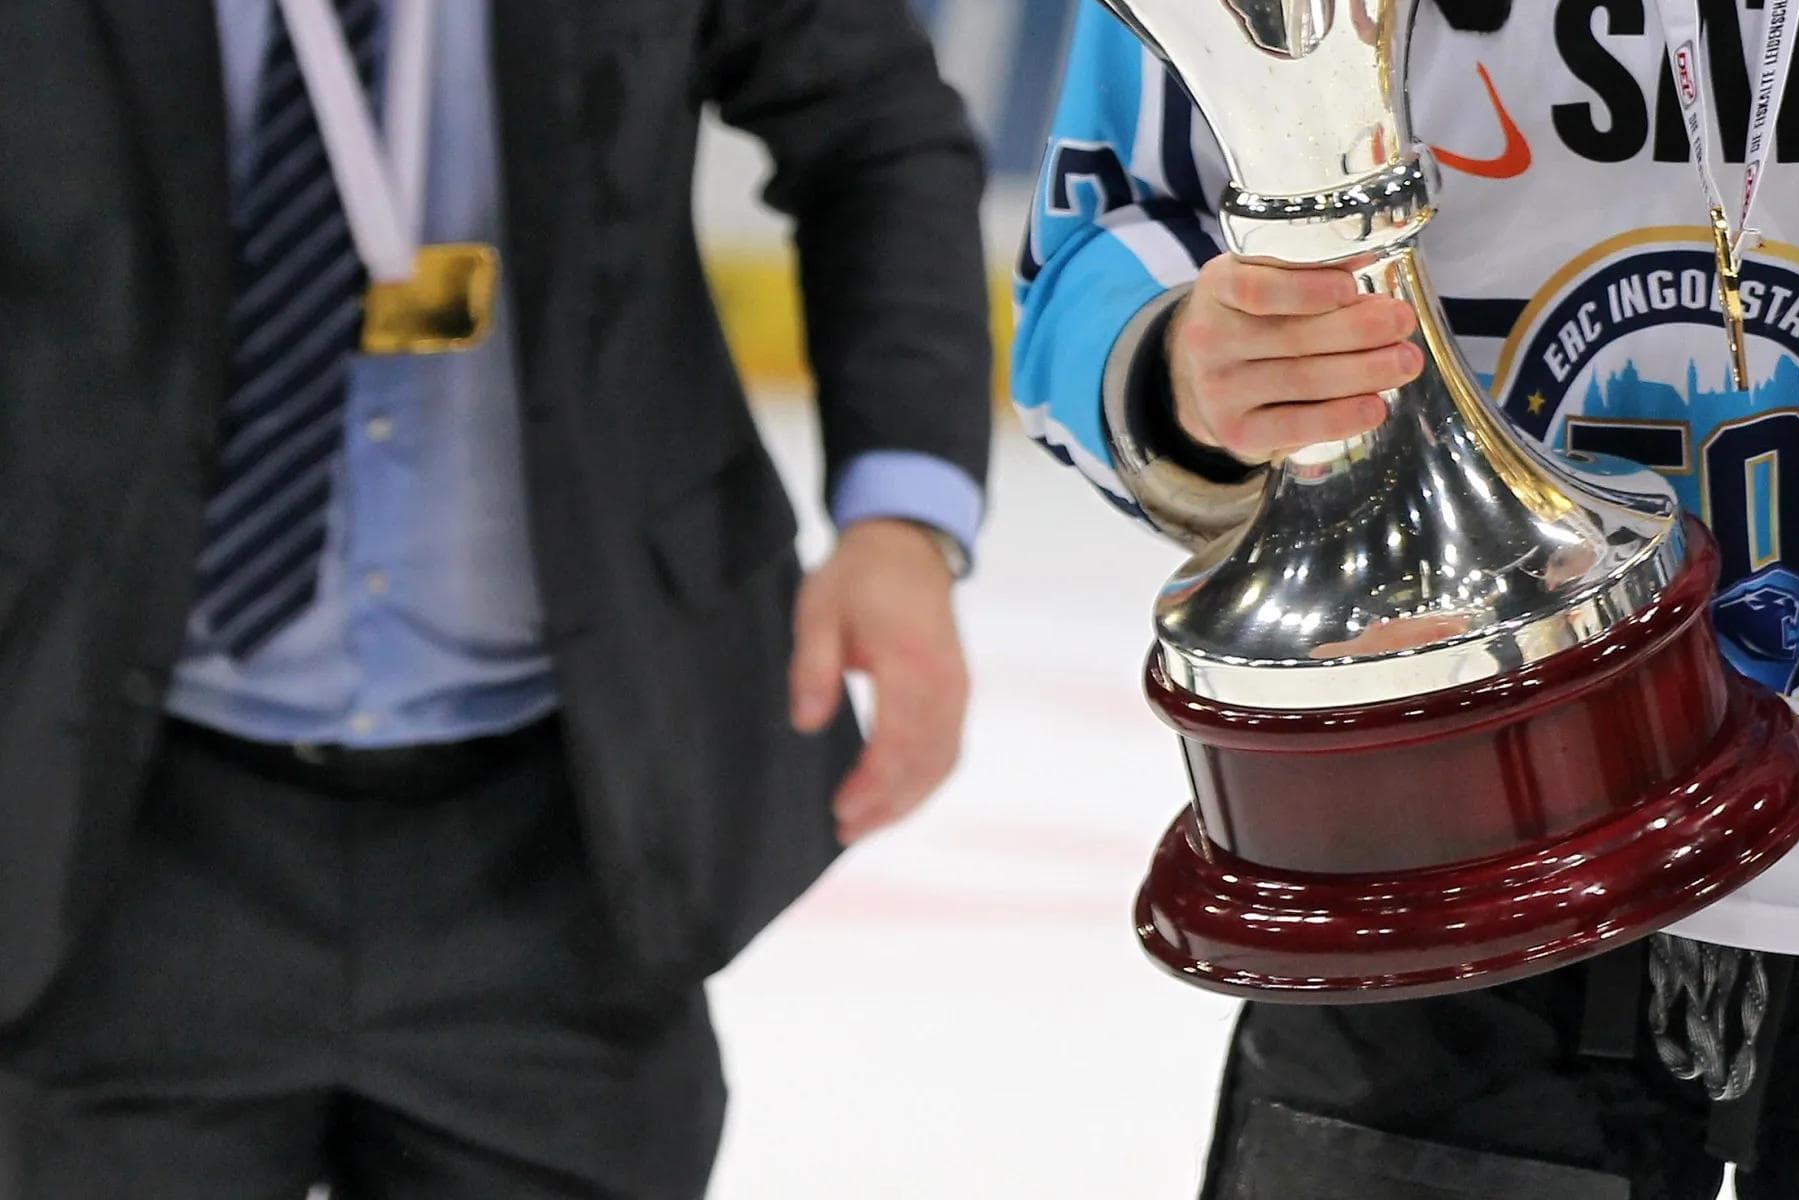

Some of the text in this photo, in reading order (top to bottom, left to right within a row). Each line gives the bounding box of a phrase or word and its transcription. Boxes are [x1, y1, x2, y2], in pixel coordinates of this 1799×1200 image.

[1753, 69, 1775, 129] EISKALTE
[1749, 132, 1762, 153] DIE
[1542, 300, 1602, 383] ERC
